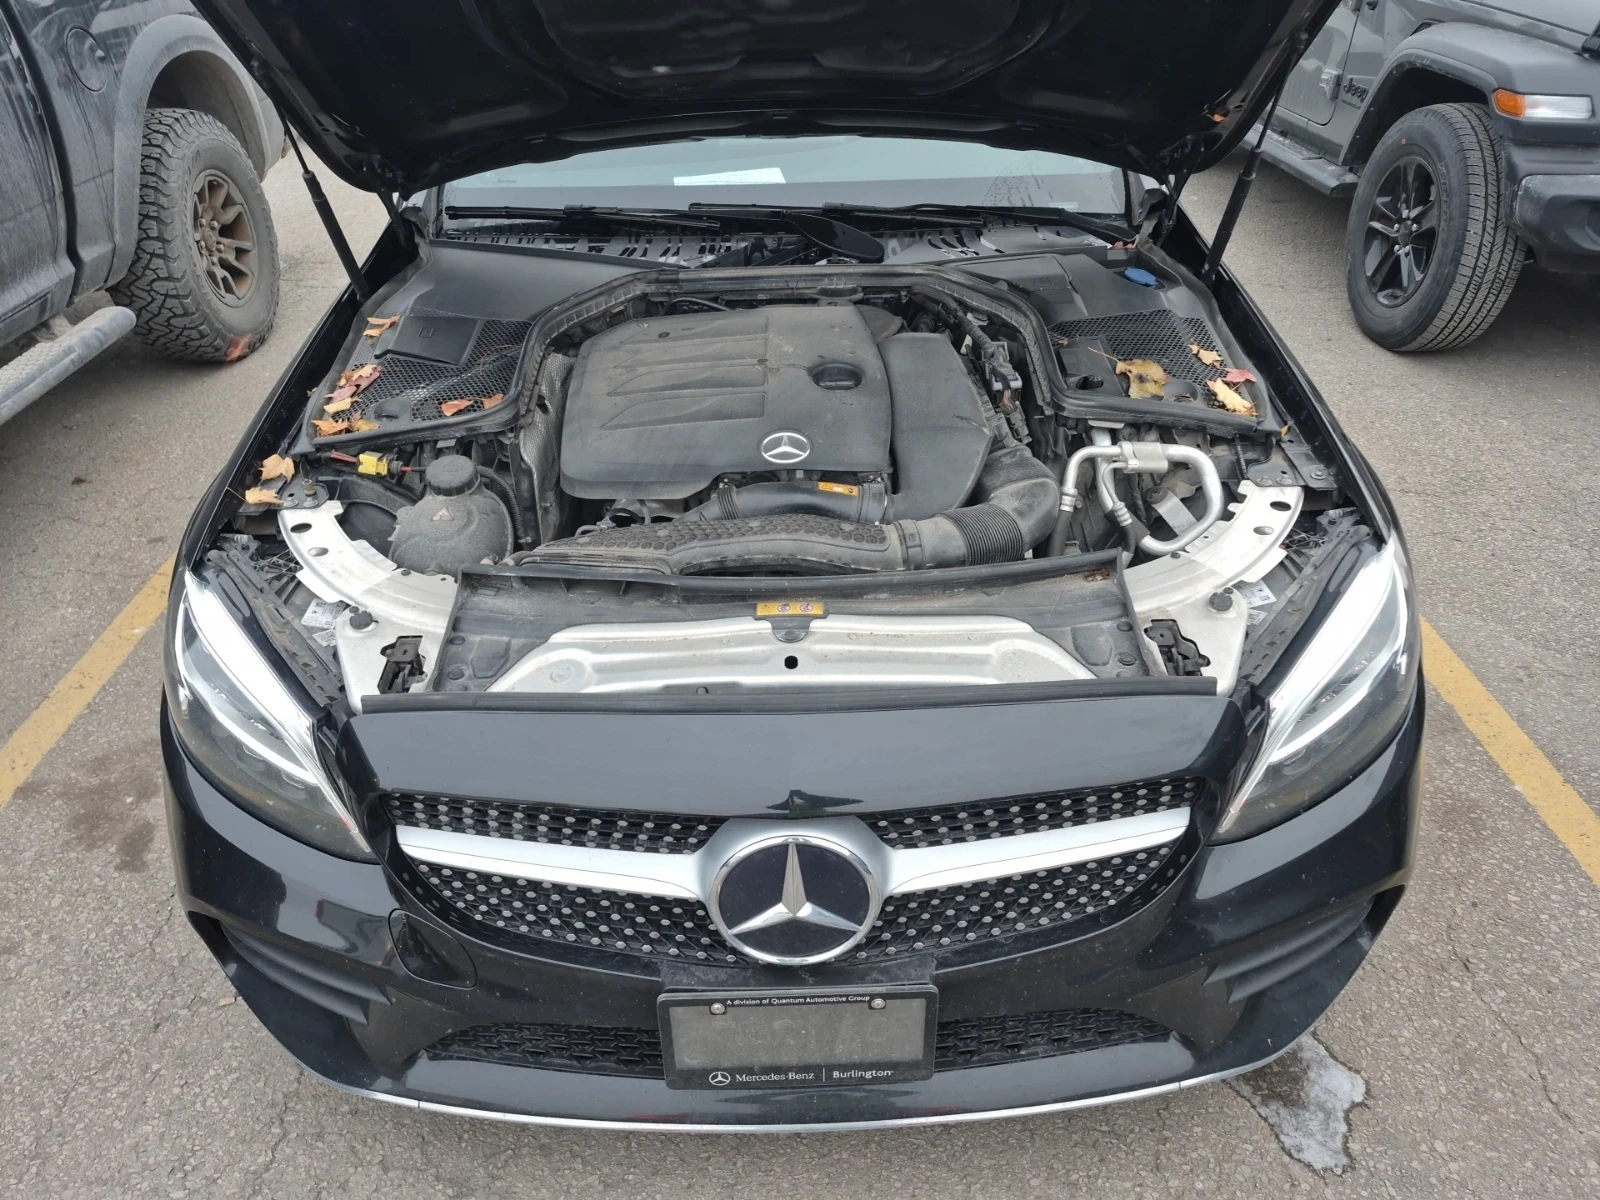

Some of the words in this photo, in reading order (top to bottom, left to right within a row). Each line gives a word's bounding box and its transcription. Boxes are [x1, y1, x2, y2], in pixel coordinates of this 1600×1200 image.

[1343, 77, 1369, 103] Jeep
[770, 996, 805, 1005] Quantum
[805, 995, 847, 1003] Automotive
[735, 1072, 815, 1083] Mercedes-Benz
[832, 1069, 892, 1080] Burlington
